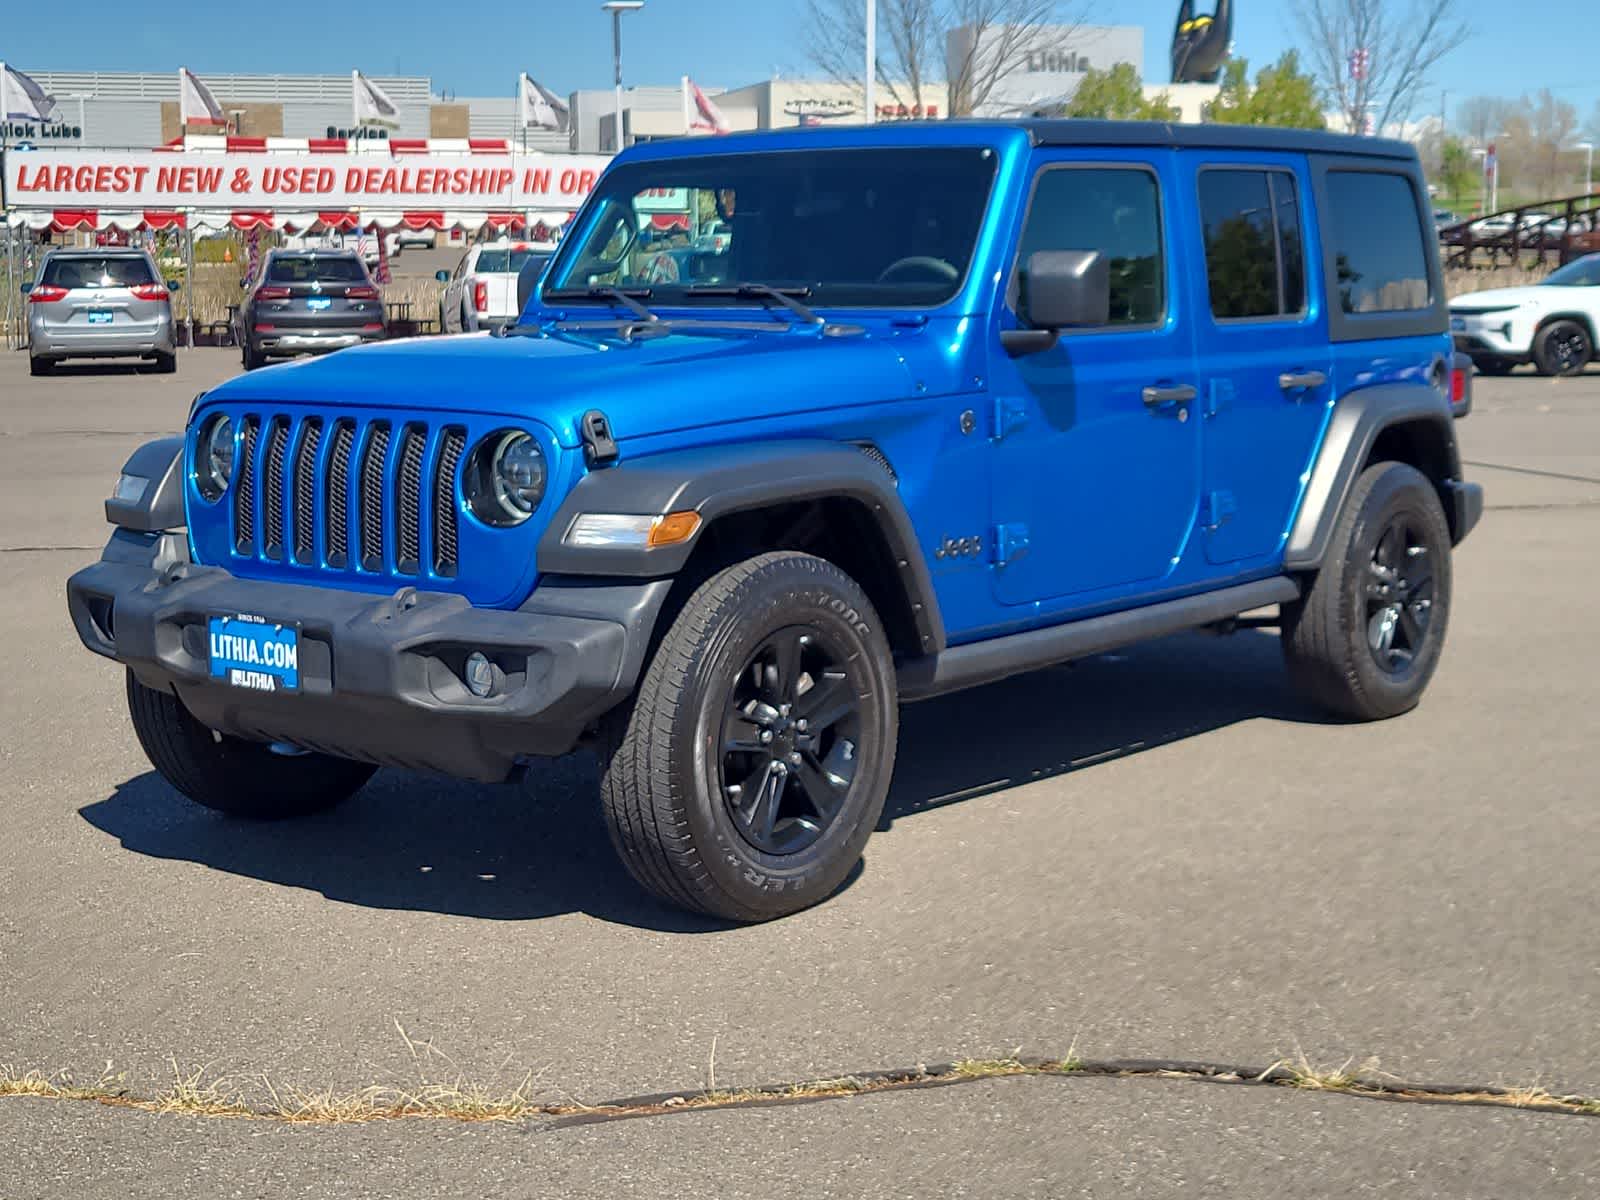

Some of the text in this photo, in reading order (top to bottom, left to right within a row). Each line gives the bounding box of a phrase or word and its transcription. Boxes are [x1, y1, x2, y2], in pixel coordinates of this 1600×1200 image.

[16, 164, 149, 192] LARGEST
[156, 166, 225, 193] NEW
[230, 166, 253, 193] &
[261, 166, 337, 193] USED
[344, 167, 516, 194] DEALERSHIP
[522, 167, 551, 194] IN
[210, 632, 298, 671] LITHIA.COM
[241, 670, 276, 692] LITHIA
